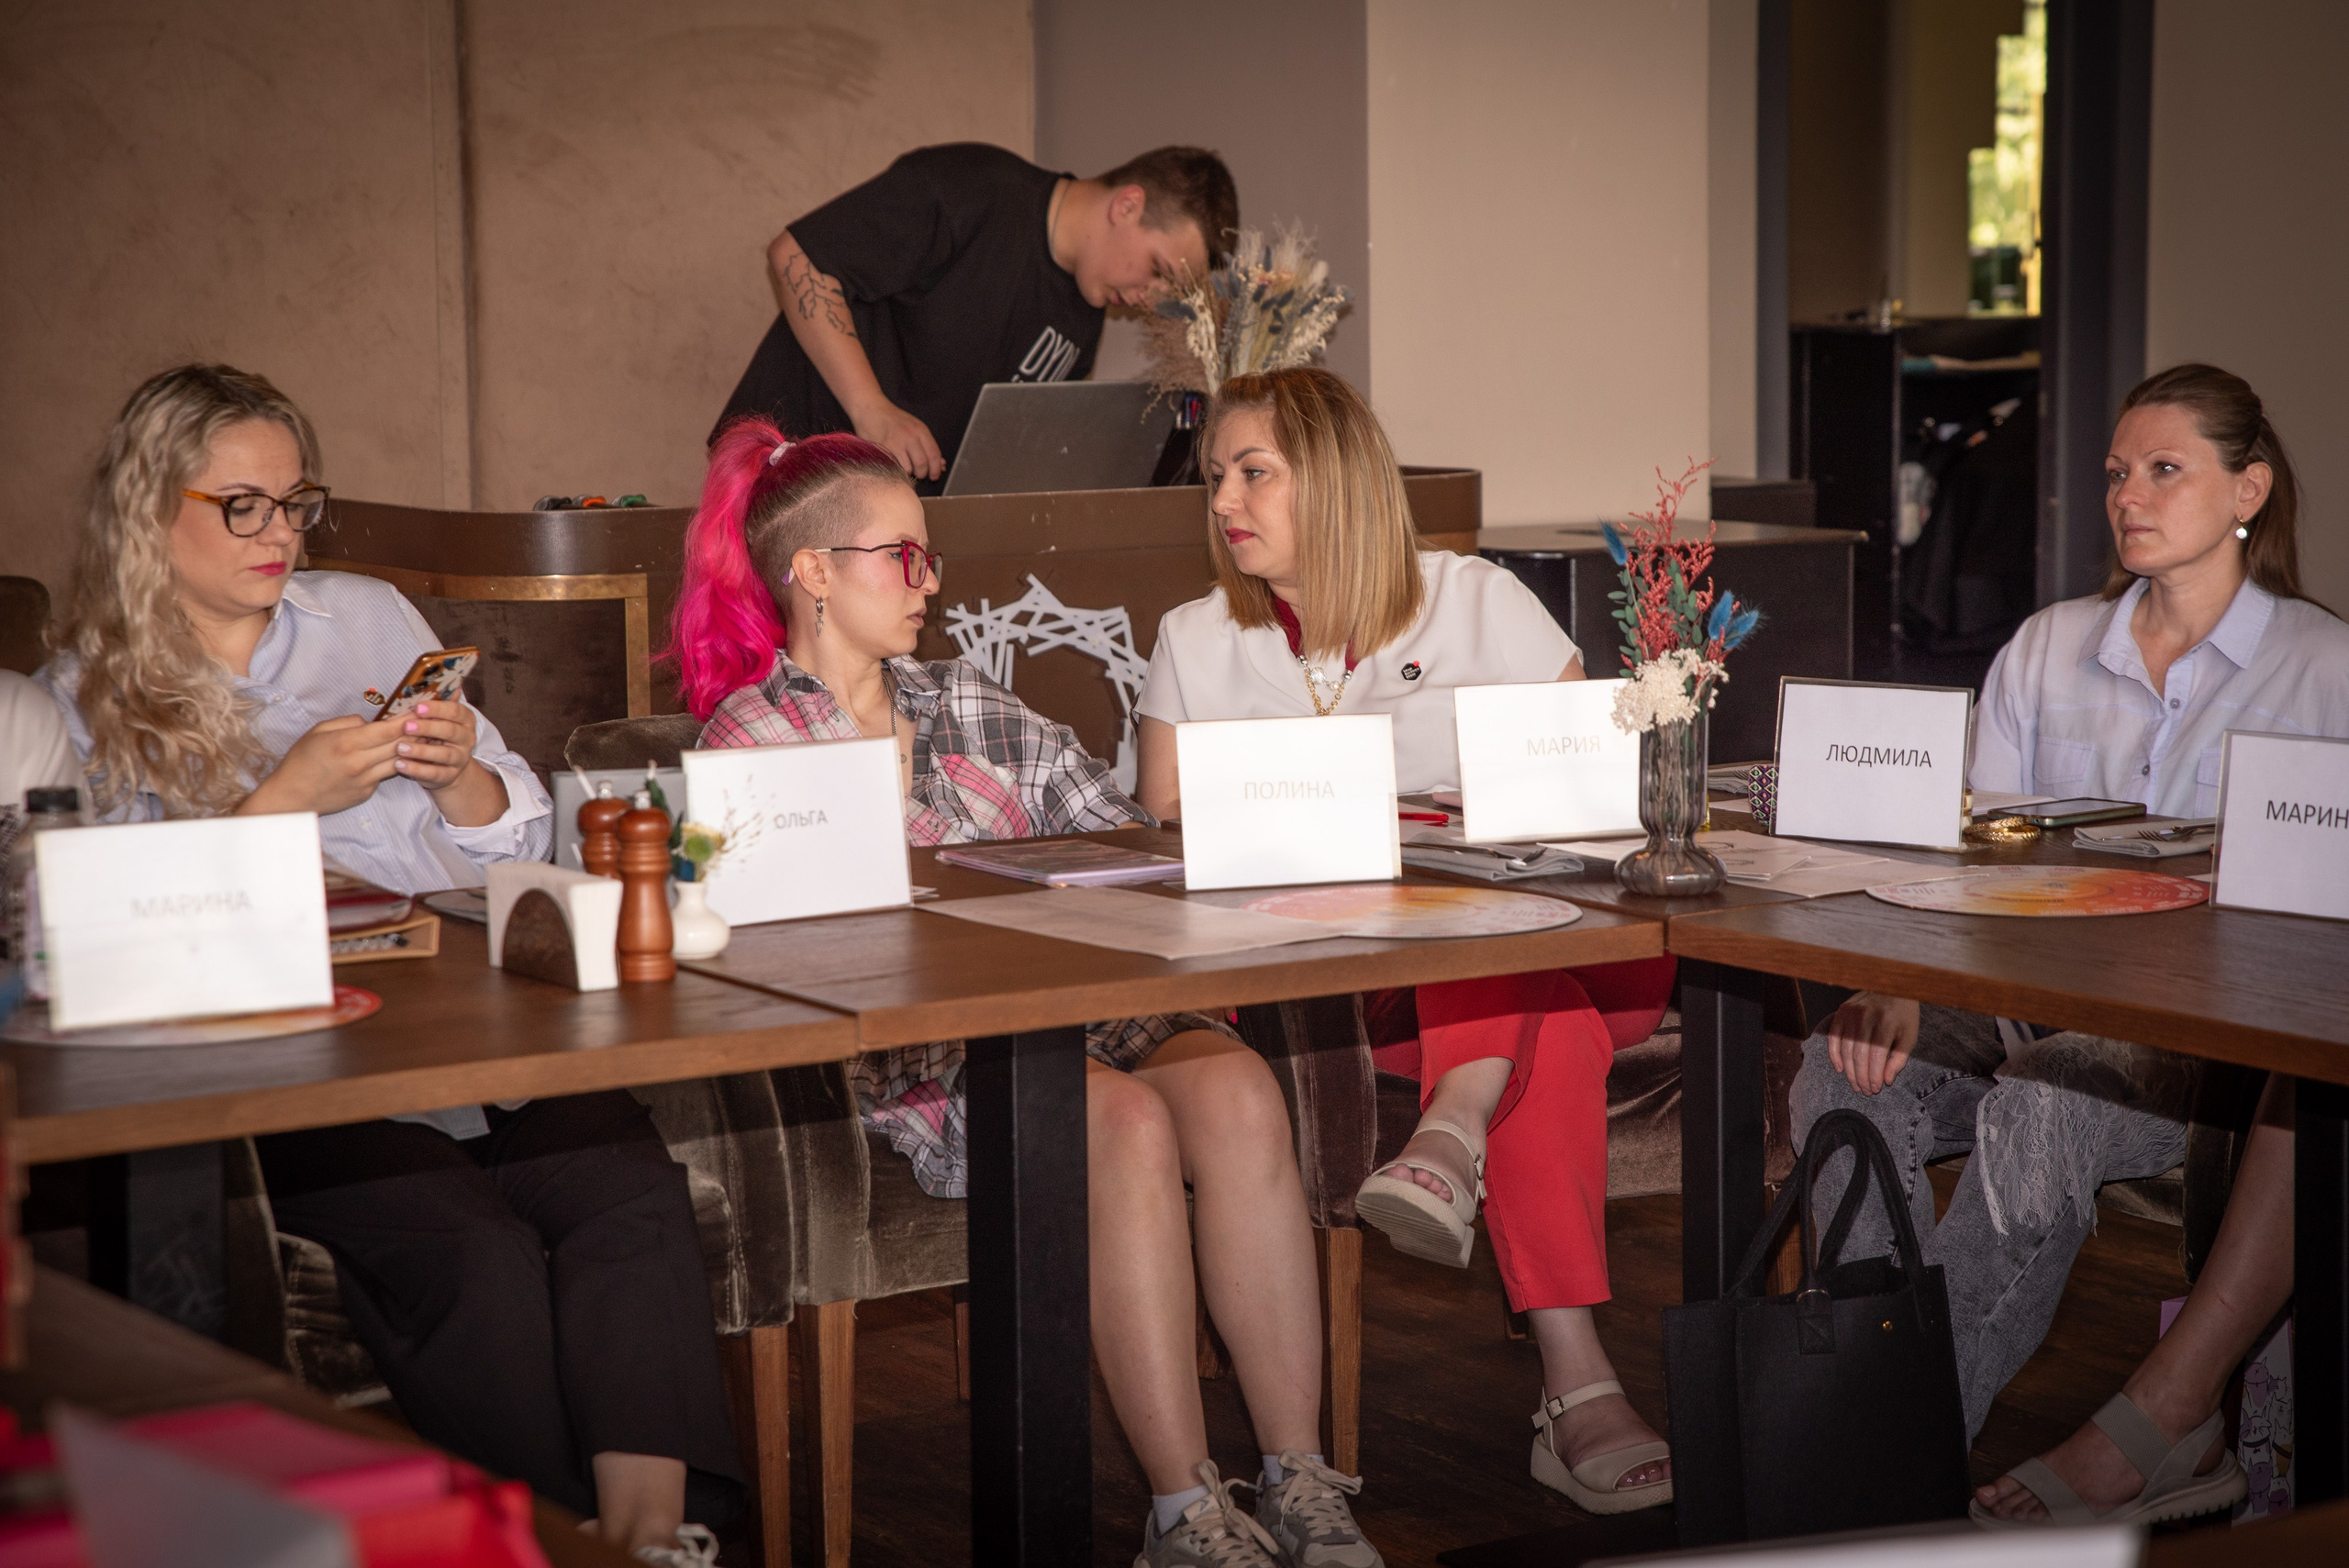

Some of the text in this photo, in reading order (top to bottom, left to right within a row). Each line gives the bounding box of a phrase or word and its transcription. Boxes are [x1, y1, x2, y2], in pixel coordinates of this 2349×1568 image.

[1526, 735, 1600, 756] МАРИЯ
[1825, 743, 1932, 768] ЛЮДМИЛА
[1243, 780, 1335, 800] ПОЛИНА
[773, 809, 829, 830] ОЛЬГА
[2266, 799, 2349, 829] МАРИН
[129, 889, 253, 919] МАРИНА
